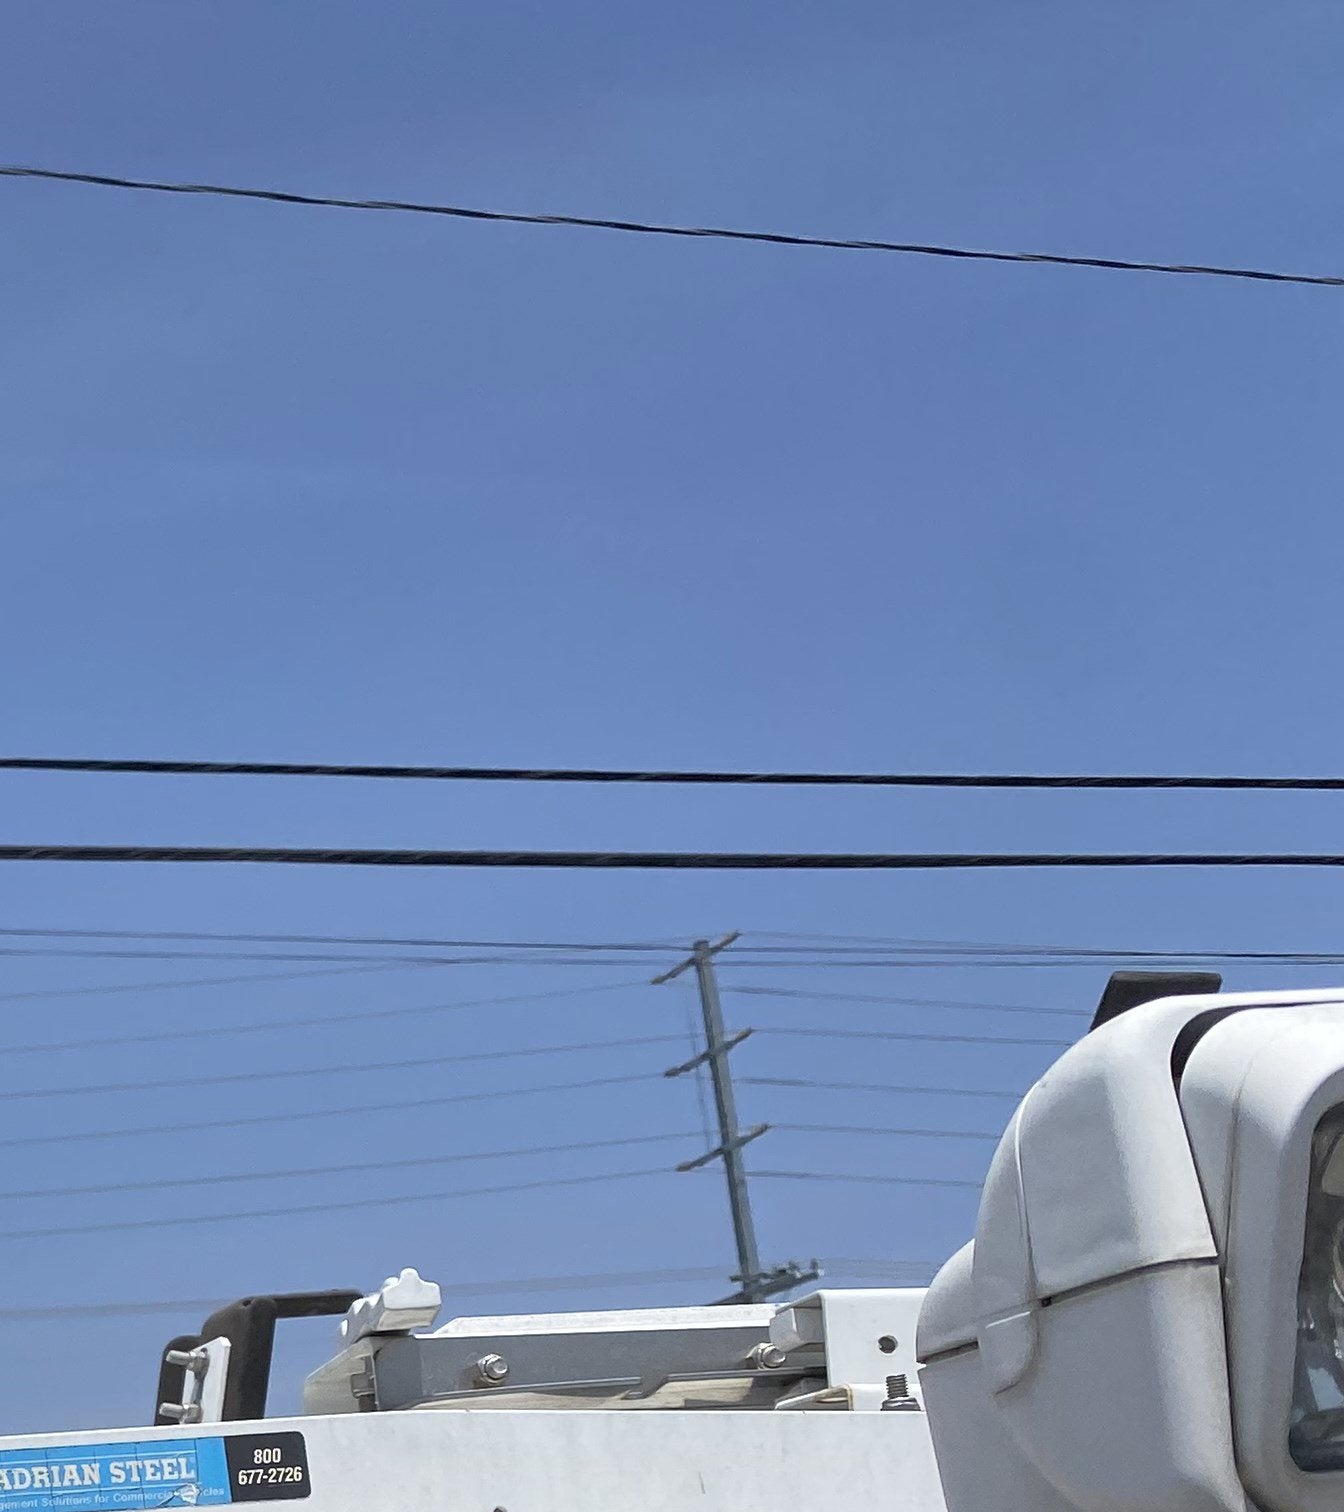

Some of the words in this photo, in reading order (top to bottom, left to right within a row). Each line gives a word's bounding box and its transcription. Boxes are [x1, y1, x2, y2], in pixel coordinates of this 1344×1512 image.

[253, 1447, 282, 1464] 800
[109, 1457, 196, 1484] STEEL
[238, 1466, 303, 1486] 677-2726
[41, 1495, 92, 1508] Solutions
[94, 1493, 110, 1504] for
[113, 1488, 175, 1503] Commercia
